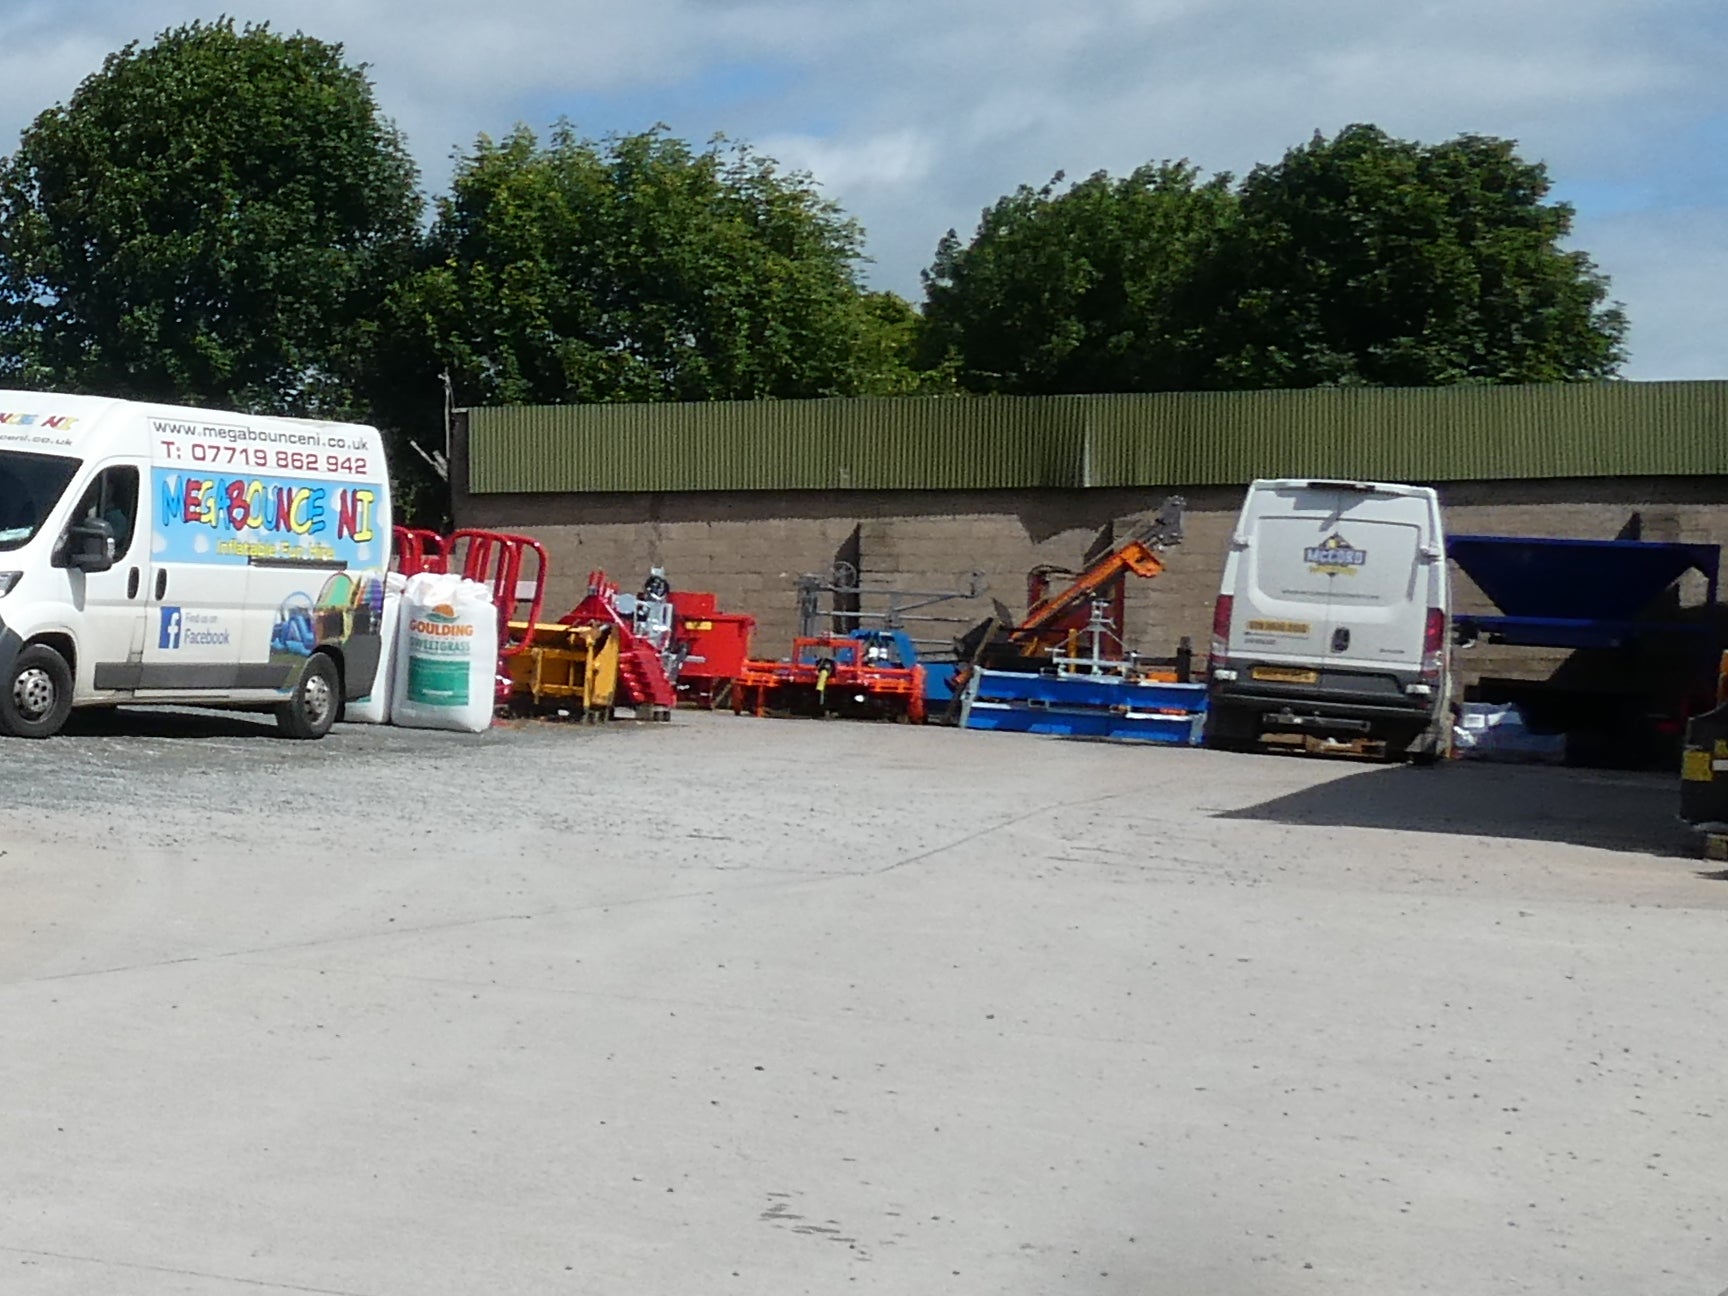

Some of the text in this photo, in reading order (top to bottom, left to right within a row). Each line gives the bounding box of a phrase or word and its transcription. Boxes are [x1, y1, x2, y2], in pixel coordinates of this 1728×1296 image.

[41, 415, 79, 432] NI
[153, 421, 369, 451] www.megabounceni.co.uk
[161, 441, 367, 475] T: 07719 862 942
[162, 474, 375, 543] MEGABOUNCE NI
[185, 628, 230, 645] Facebook
[409, 619, 474, 637] GOULDING
